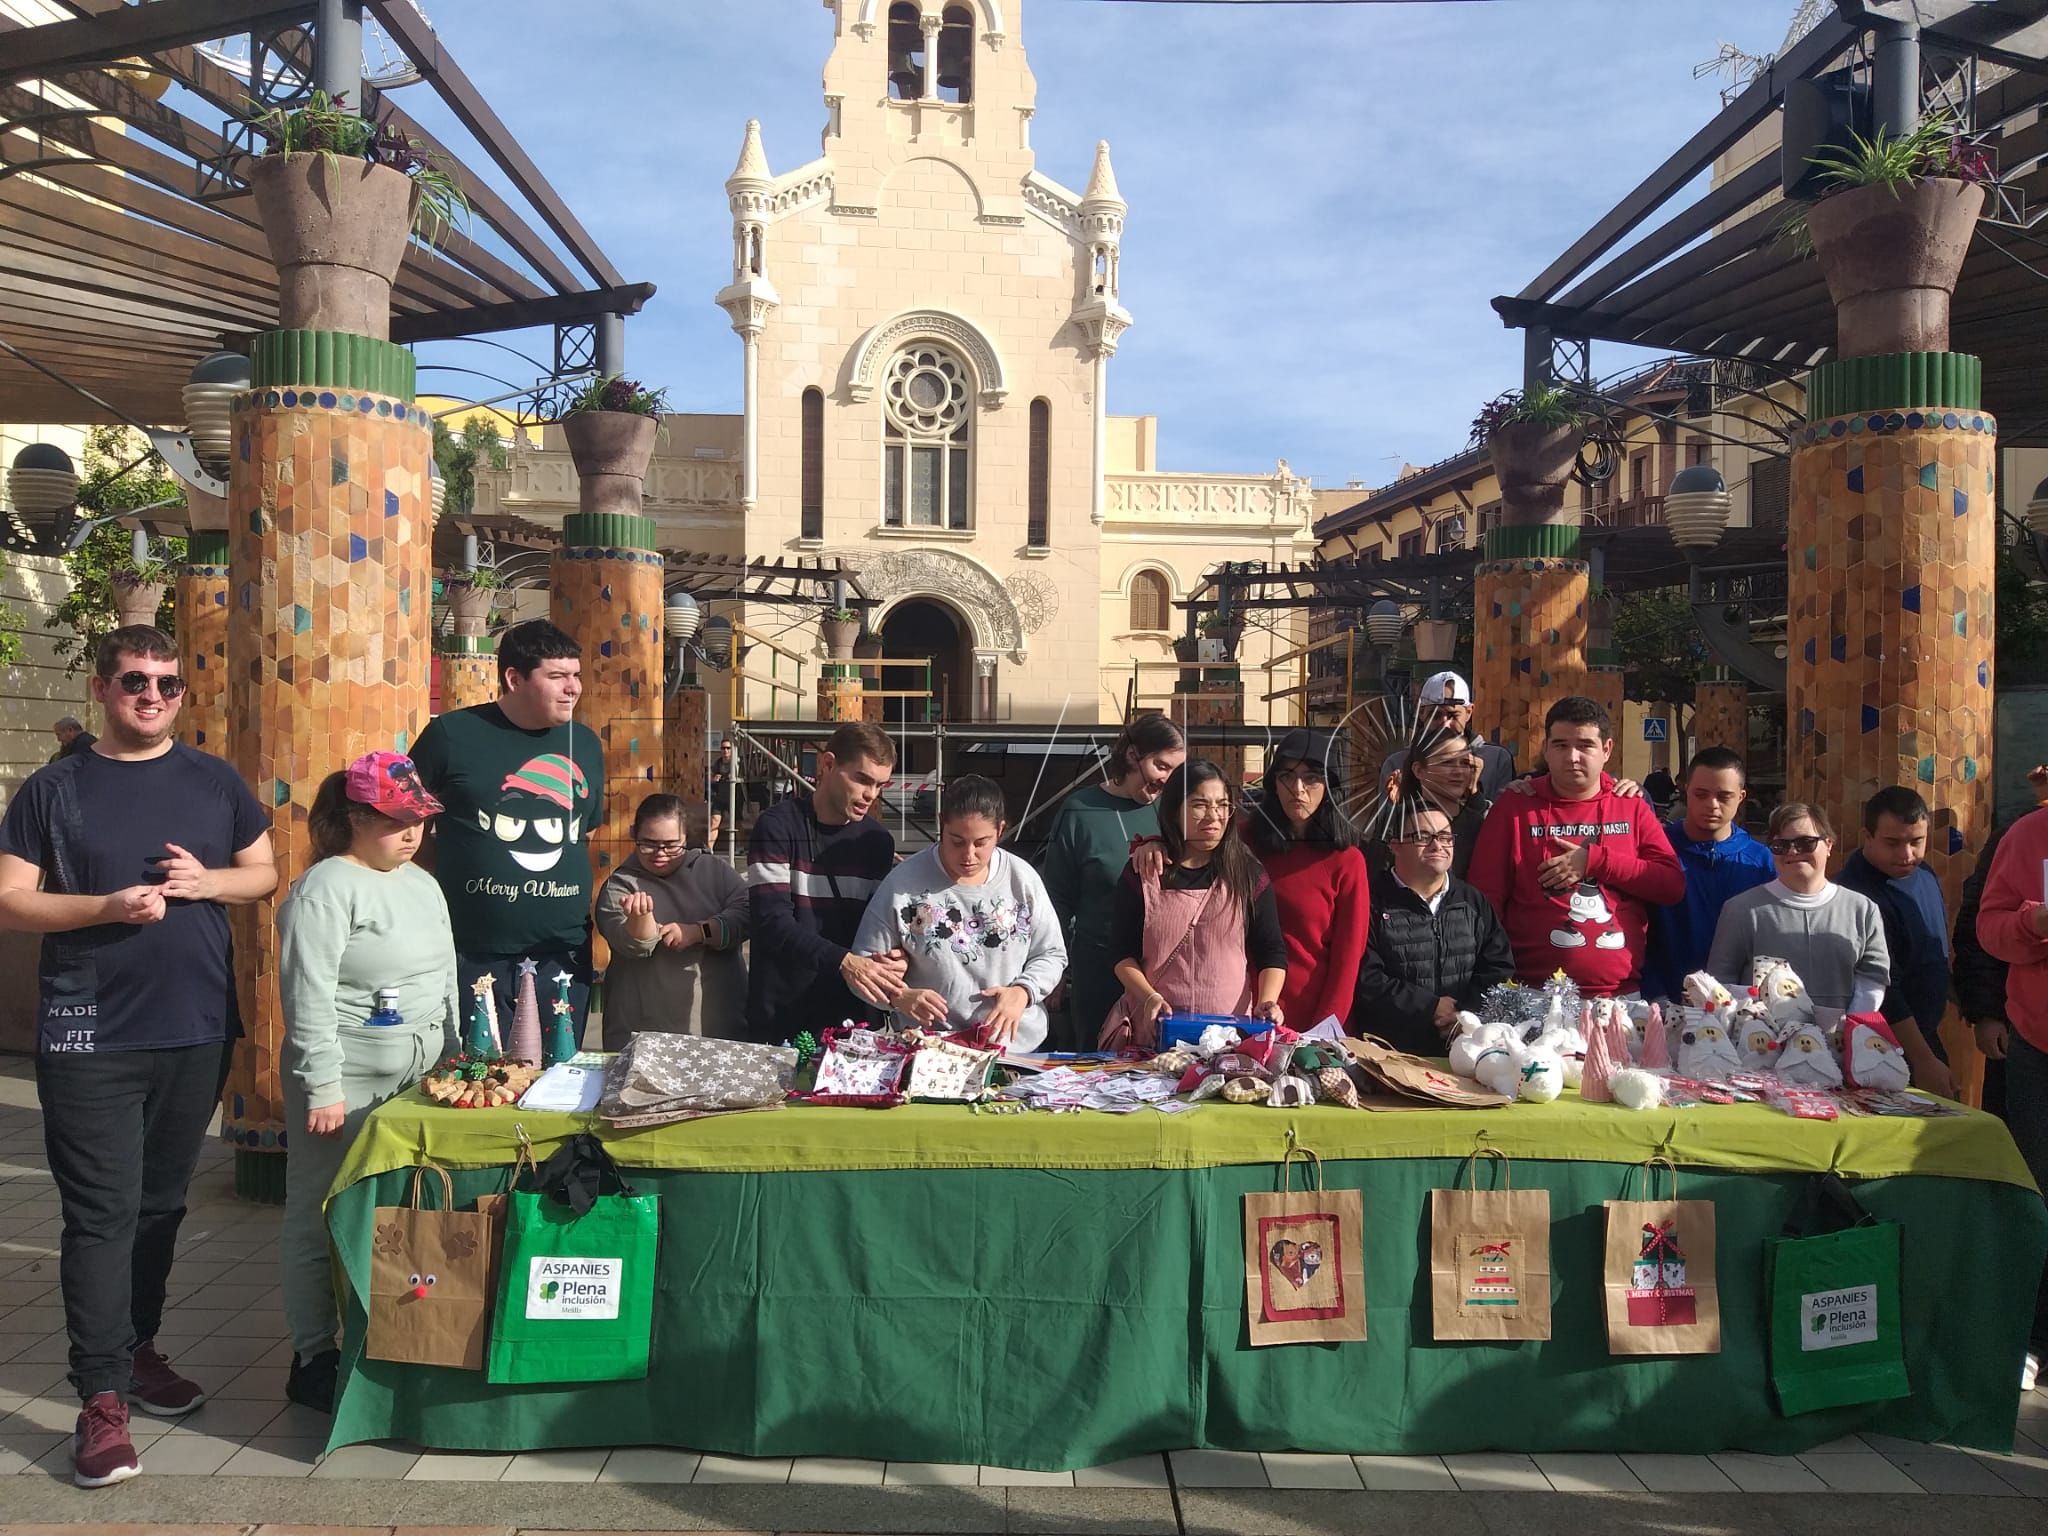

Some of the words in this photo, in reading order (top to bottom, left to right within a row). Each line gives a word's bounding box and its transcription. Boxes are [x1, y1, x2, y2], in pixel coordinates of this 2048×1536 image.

[1531, 826, 1546, 838] NO
[1549, 826, 1577, 837] READY
[1578, 824, 1595, 836] FOR
[465, 876, 519, 903] Merry
[47, 1005, 98, 1017] MADE
[66, 1030, 95, 1042] FIT
[49, 1042, 95, 1053] NESS
[542, 1263, 610, 1276] ASPANIES
[562, 1281, 607, 1296] Plena
[561, 1295, 606, 1305] inclusión
[1812, 1291, 1868, 1309] ASPANIES
[1829, 1310, 1867, 1324] Plena
[1829, 1321, 1866, 1333] inclusión
